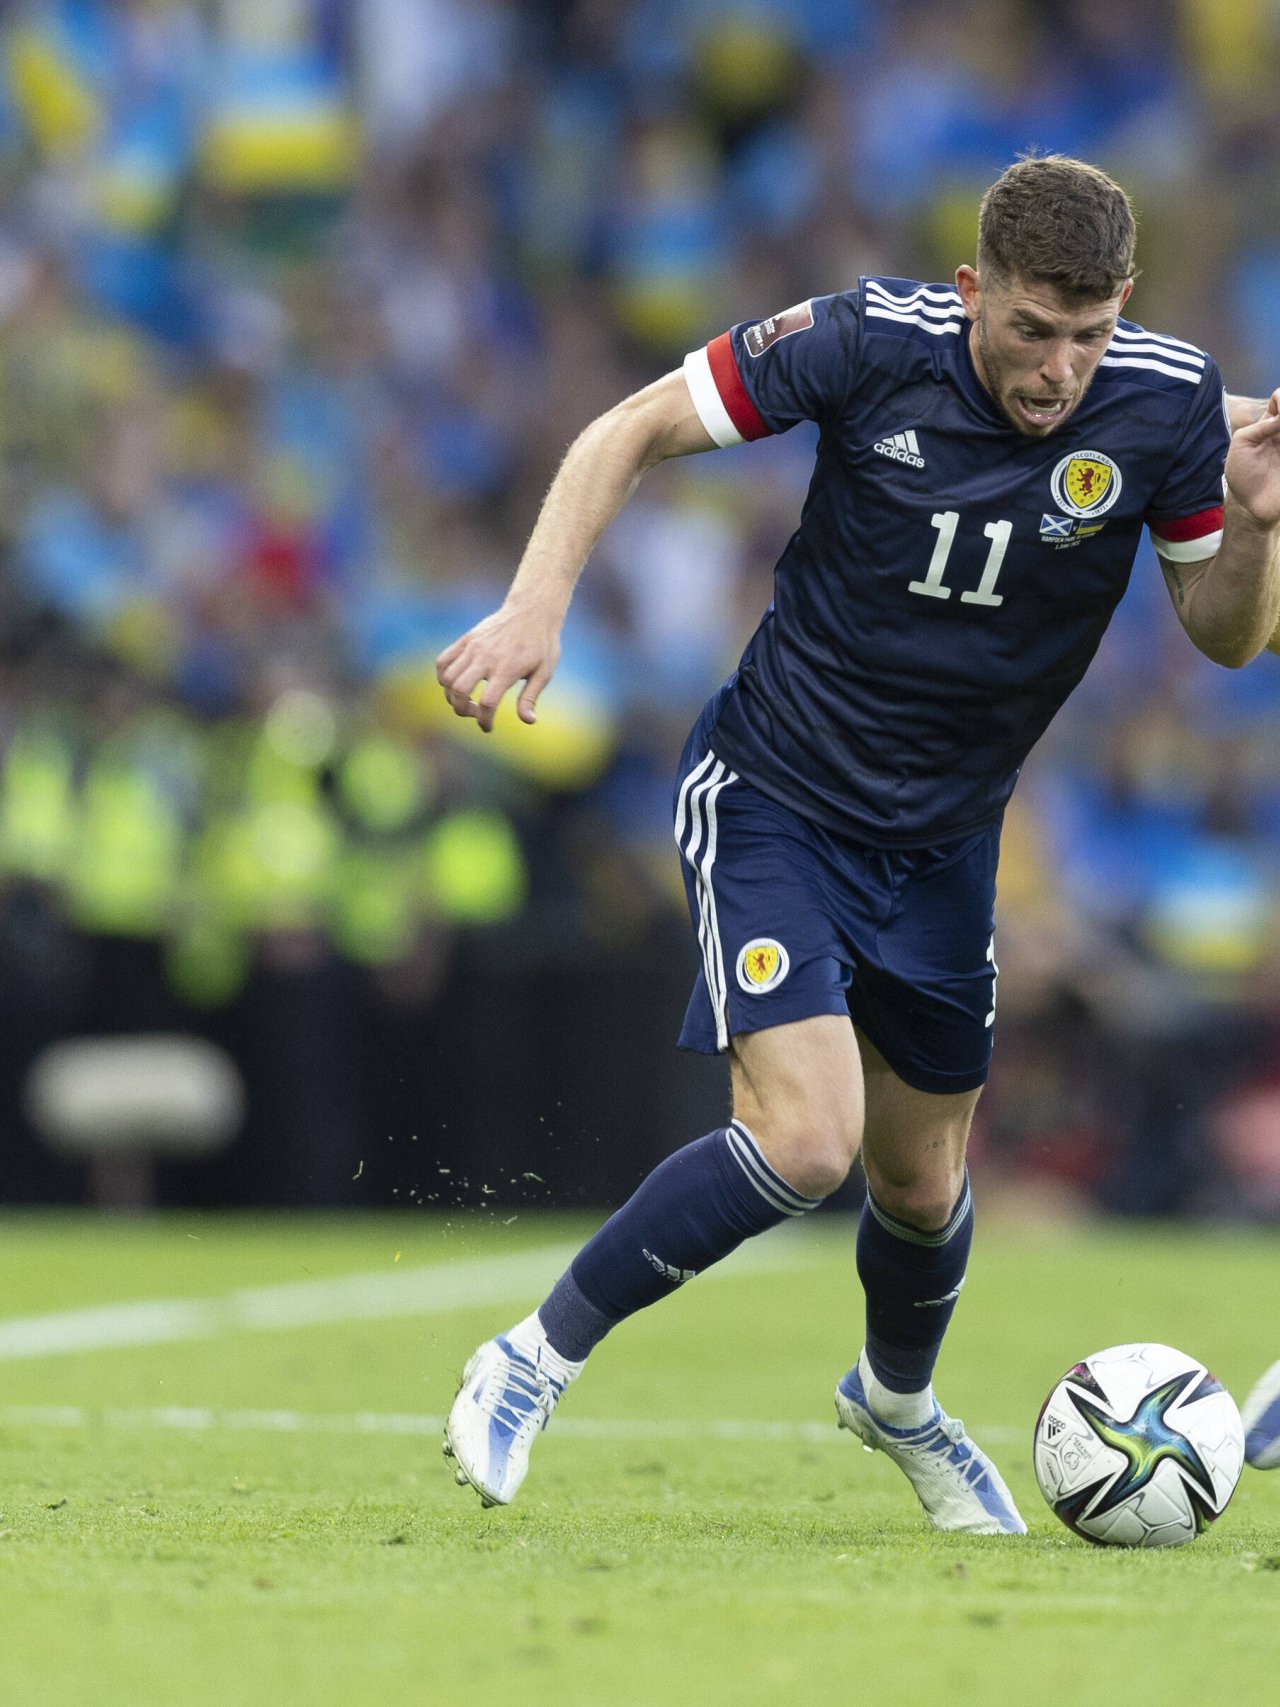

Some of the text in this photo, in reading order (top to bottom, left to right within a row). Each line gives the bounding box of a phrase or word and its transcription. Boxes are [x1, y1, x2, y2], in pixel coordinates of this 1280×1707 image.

[873, 442, 925, 468] adidas
[1075, 452, 1110, 465] SCOTLAND
[908, 511, 1013, 606] 11
